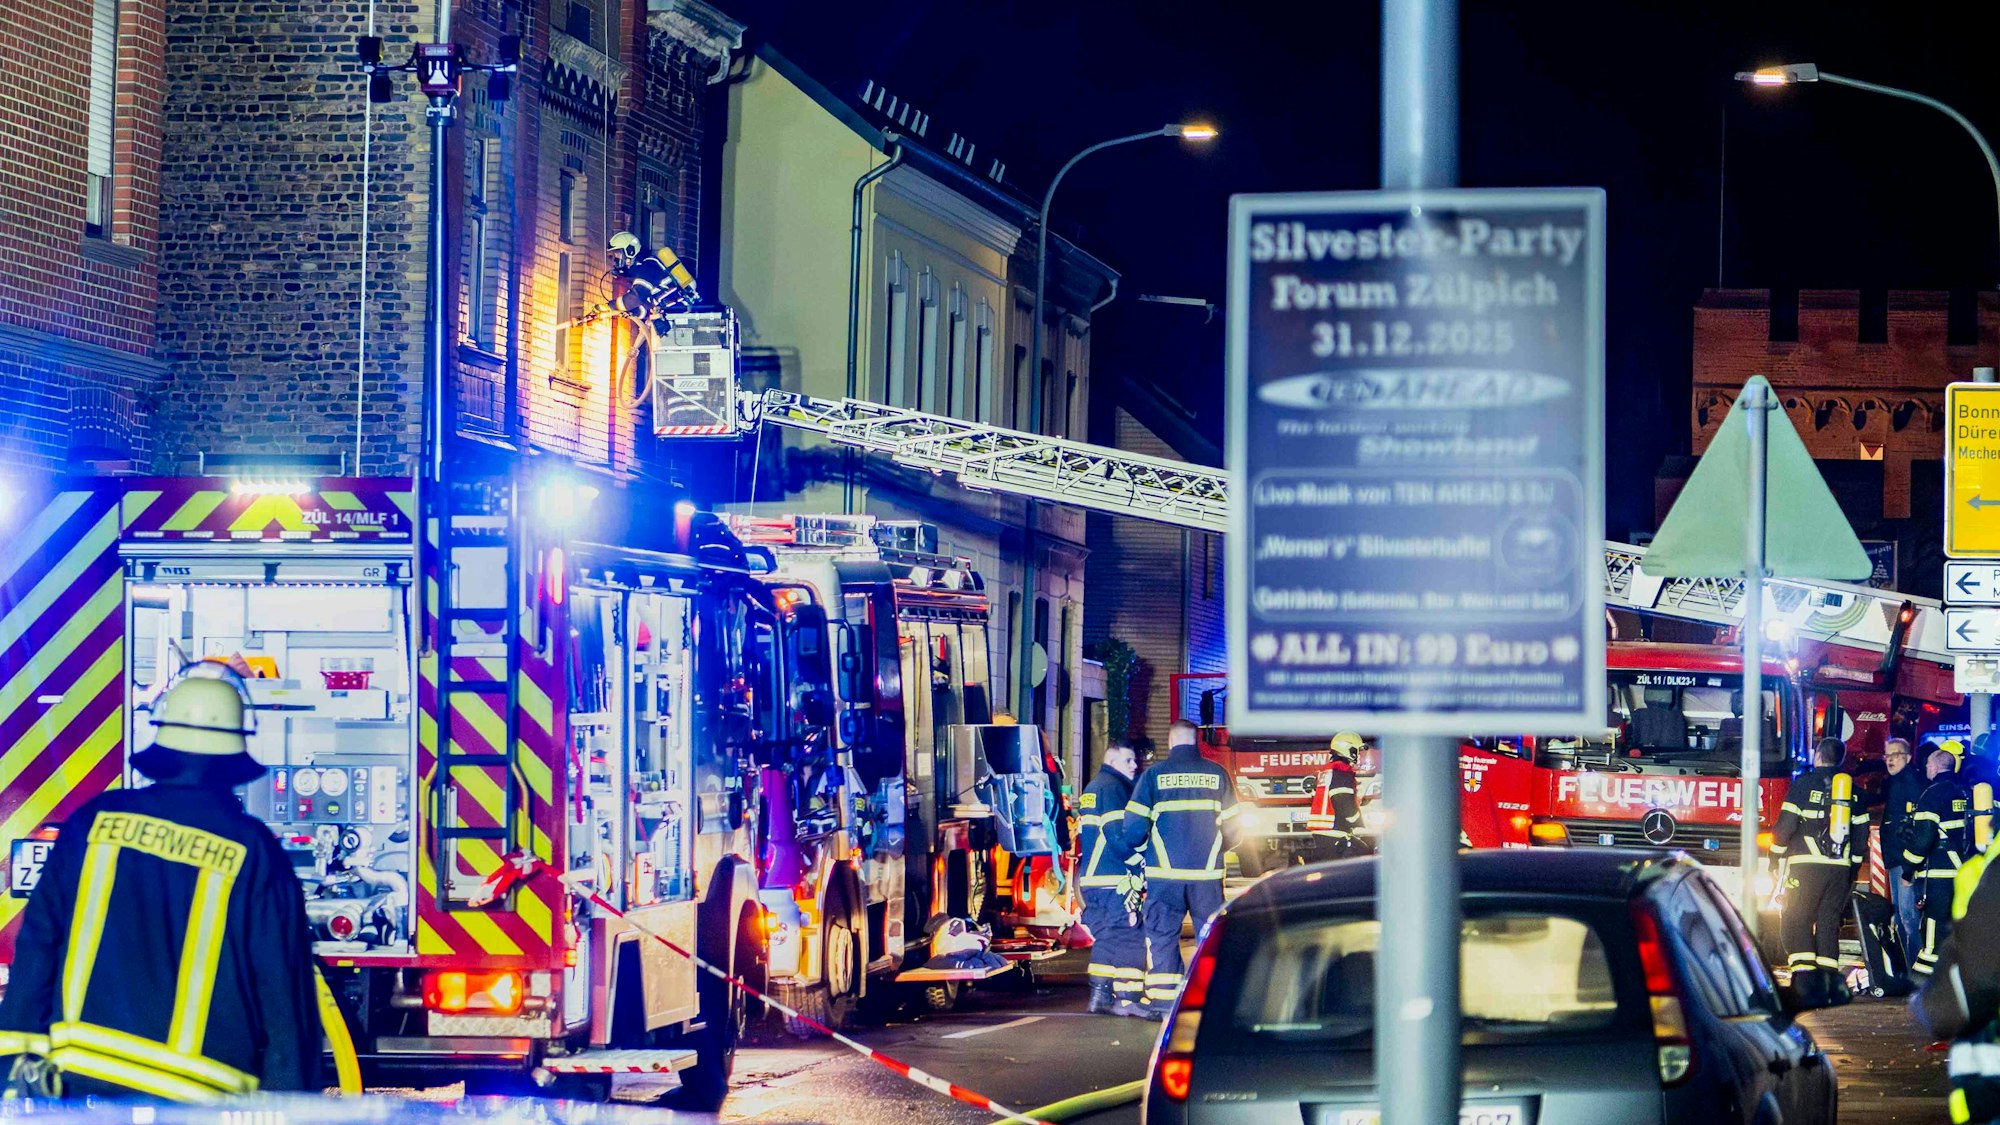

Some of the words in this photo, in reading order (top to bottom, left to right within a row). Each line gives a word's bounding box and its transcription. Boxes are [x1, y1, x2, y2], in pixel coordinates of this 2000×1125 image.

[1252, 219, 1584, 266] Silvester-Party
[1271, 275, 1397, 310] Forum
[1405, 270, 1560, 313] Zülpich
[1312, 320, 1515, 356] 31.12.2025
[1959, 405, 2000, 418] Bonn
[1959, 425, 2000, 439] Düre
[1959, 446, 2000, 459] Meche
[302, 509, 331, 524] ZÜL
[335, 511, 387, 524] 14/MLF
[391, 513, 398, 524] 1
[363, 567, 380, 577] GR
[1281, 633, 1351, 665] ALL
[1356, 633, 1411, 665] IN:
[1416, 633, 1457, 665] 99
[1466, 633, 1549, 665] Euro
[1636, 674, 1651, 685] ZÜL
[1260, 754, 1360, 767] FEUERW
[1160, 775, 1217, 787] FEUERWEHR
[95, 817, 238, 872] FEUERWEHR
